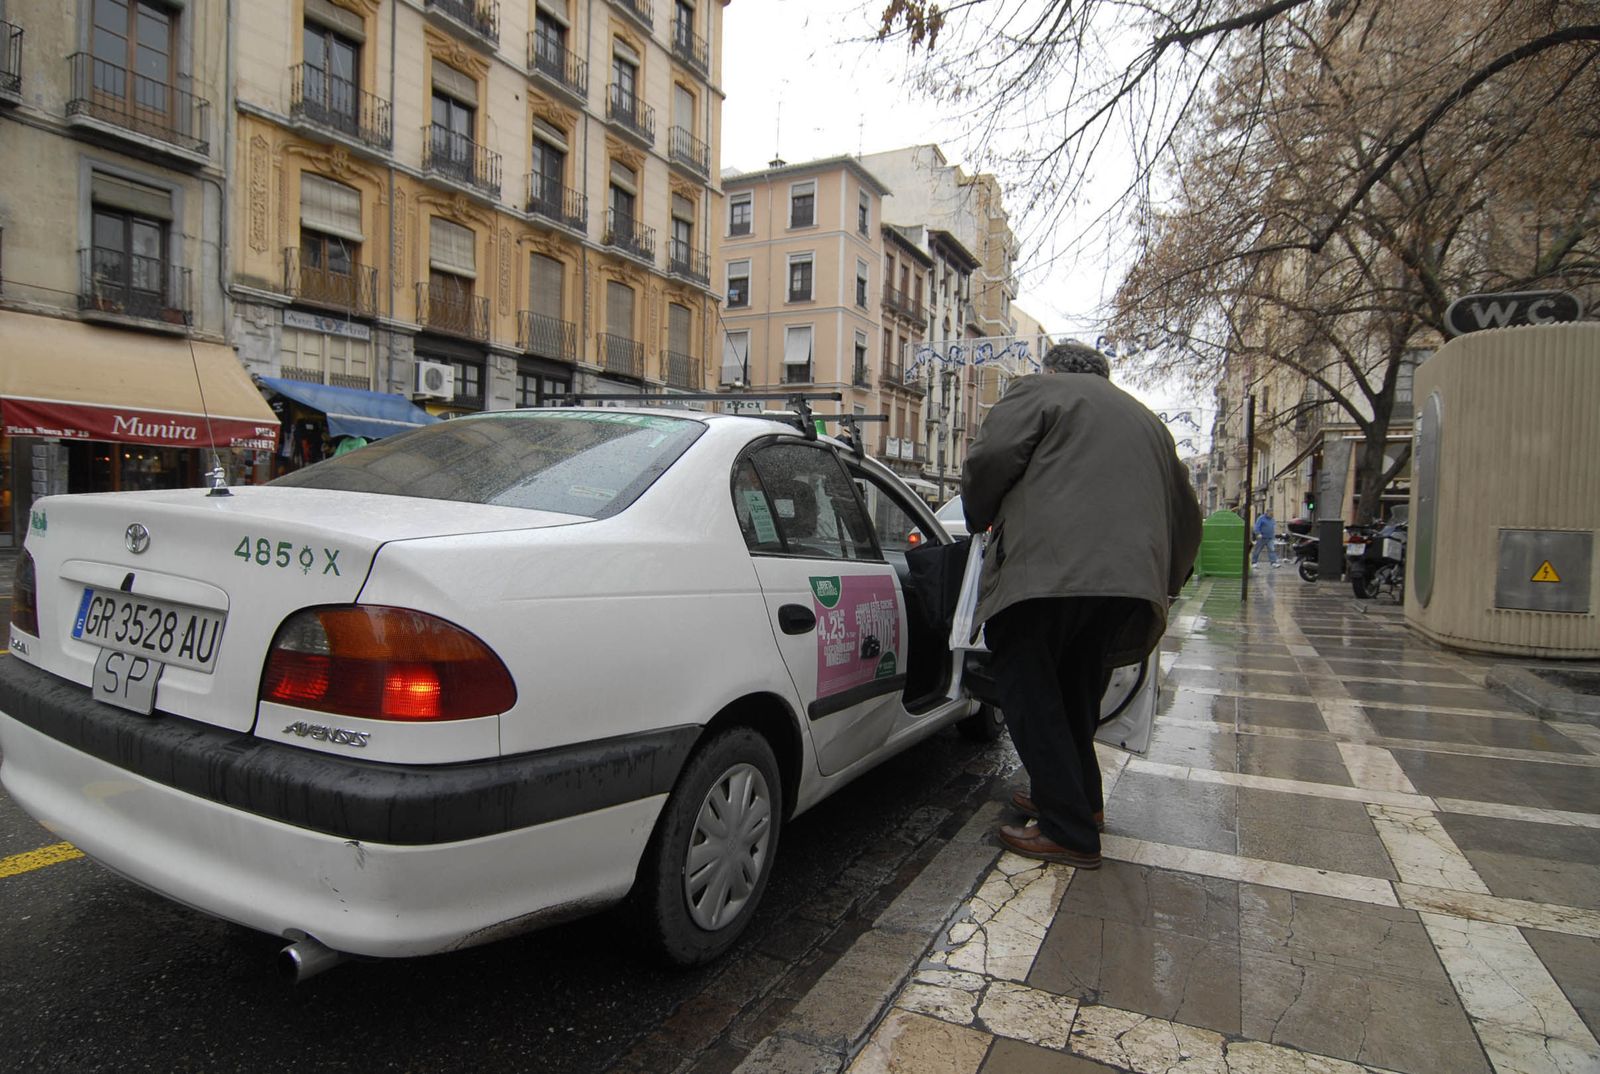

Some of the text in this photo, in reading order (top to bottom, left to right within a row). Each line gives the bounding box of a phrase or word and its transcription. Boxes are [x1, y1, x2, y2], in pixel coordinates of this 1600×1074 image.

[1470, 298, 1557, 330] WC
[111, 414, 198, 441] Munira
[234, 535, 342, 576] 485 X
[85, 595, 219, 663] GR 3528 AU
[818, 615, 846, 645] 4,25
[102, 651, 149, 699] SP
